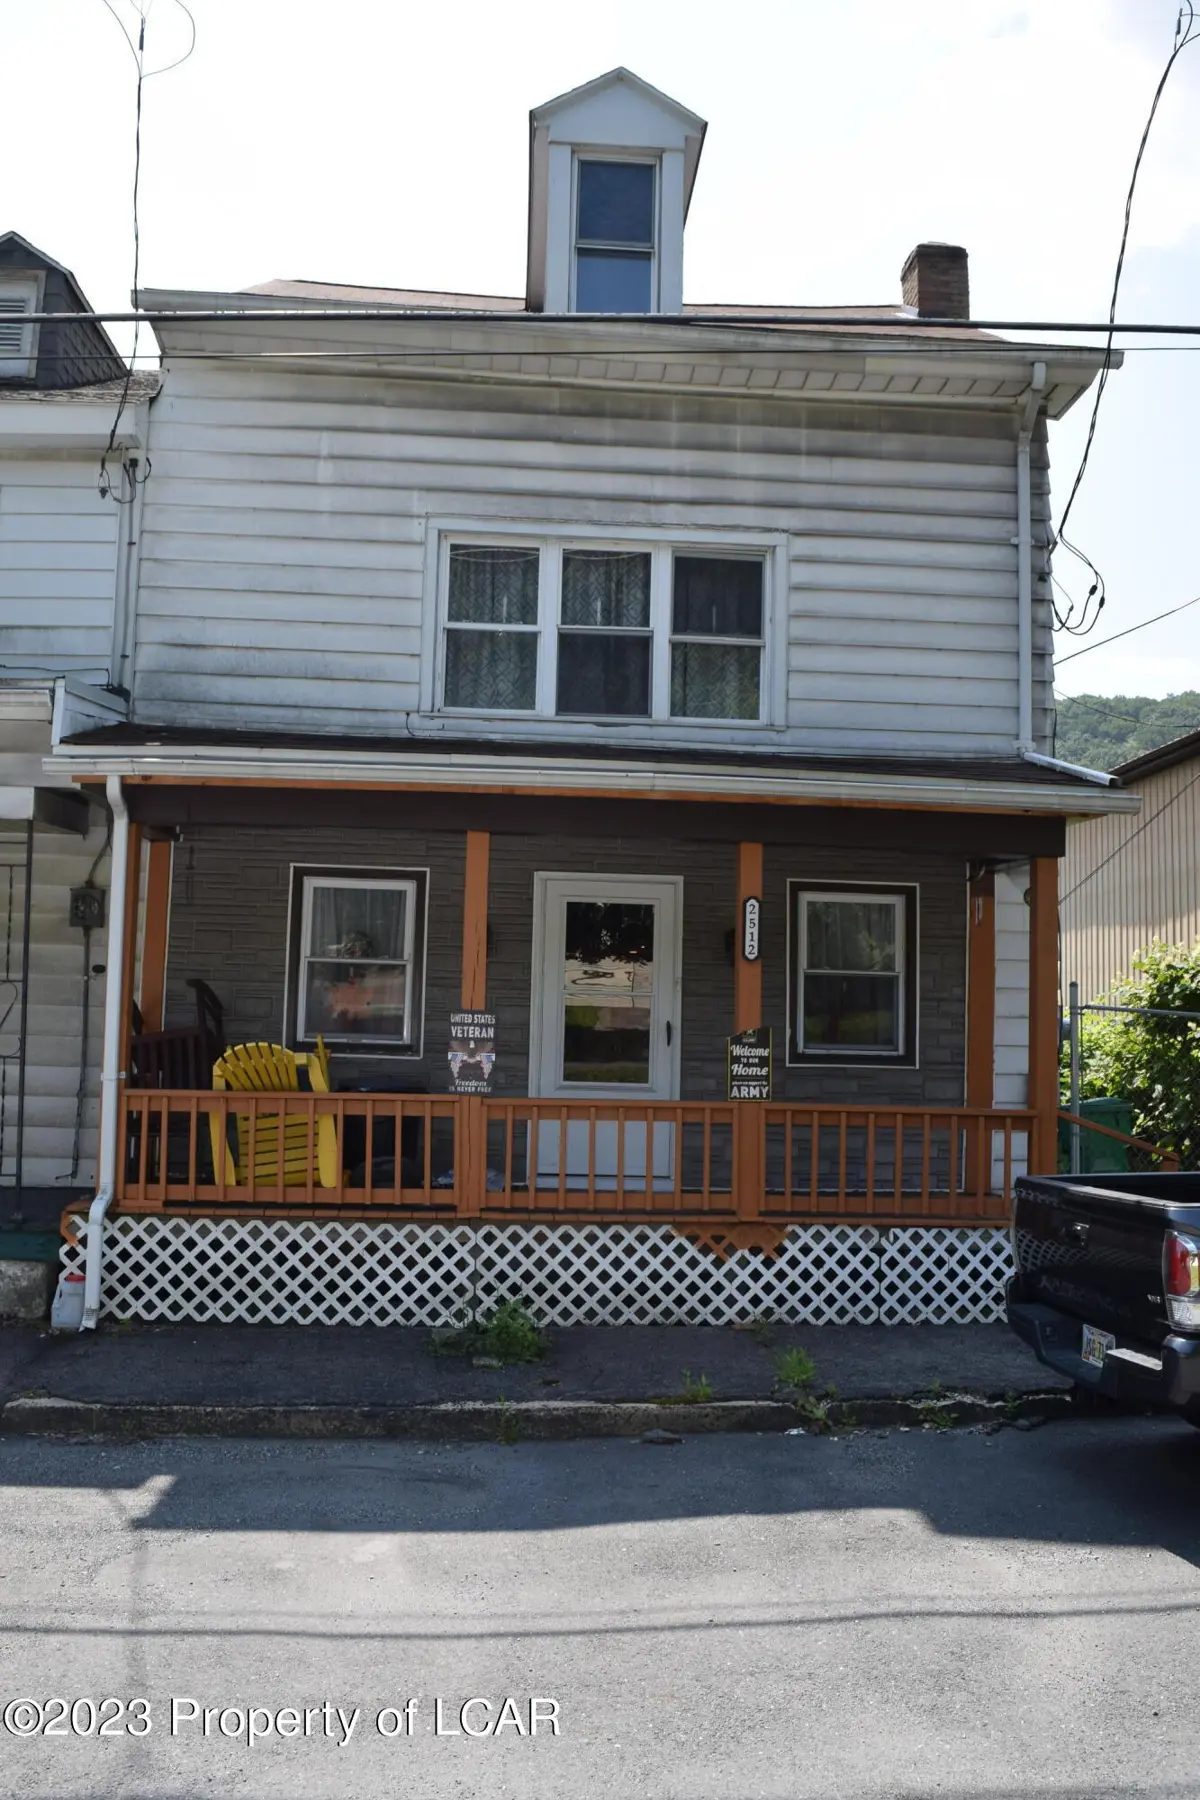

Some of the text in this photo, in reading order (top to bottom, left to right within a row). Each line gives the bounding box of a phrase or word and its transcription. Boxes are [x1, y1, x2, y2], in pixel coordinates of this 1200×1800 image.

[748, 903, 756, 955] 2512
[450, 1013, 496, 1024] UNITED STATES
[451, 1025, 494, 1039] VETERAN
[730, 1044, 770, 1057] Welcome
[731, 1063, 769, 1076] Home
[730, 1086, 769, 1098] ARMY
